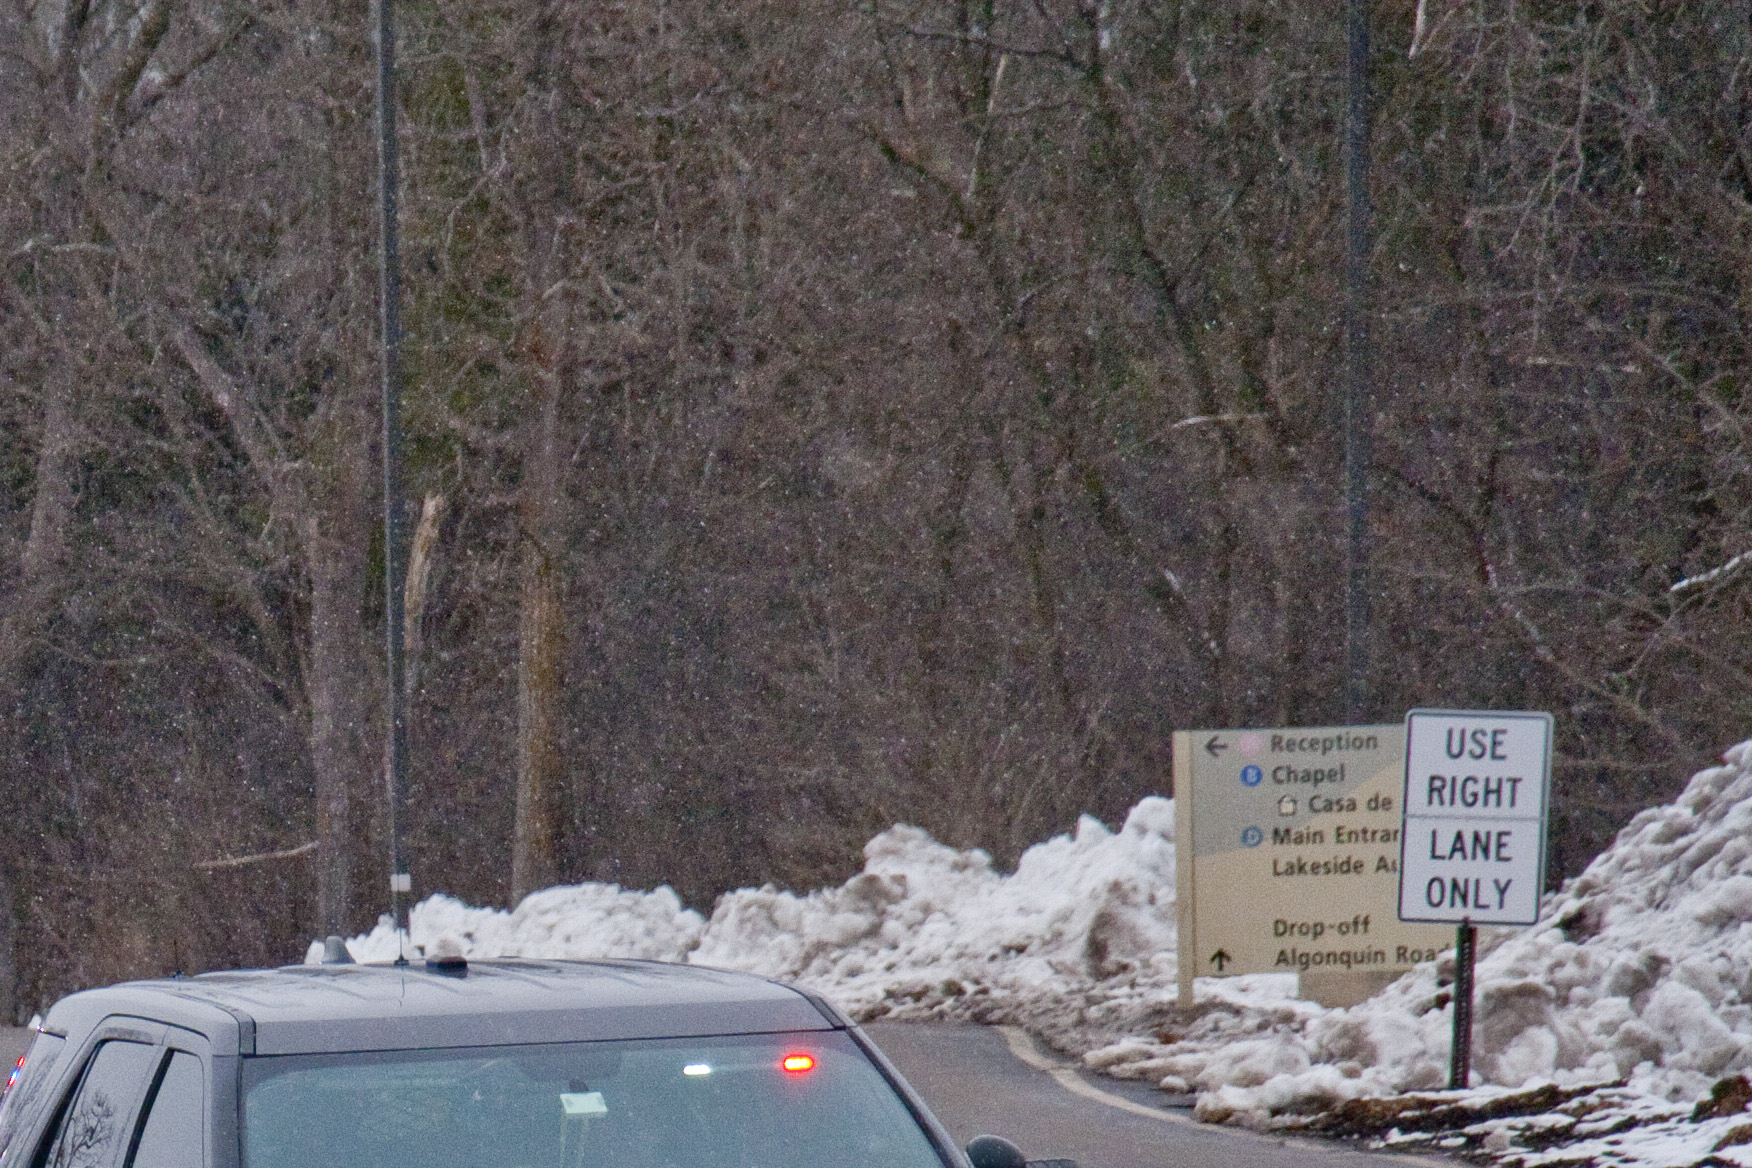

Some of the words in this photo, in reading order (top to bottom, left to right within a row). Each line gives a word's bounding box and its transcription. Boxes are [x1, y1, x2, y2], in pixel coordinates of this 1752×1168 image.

[1270, 732, 1379, 755] Reception
[1447, 727, 1508, 760] USE
[1271, 763, 1346, 787] Chapel
[1308, 794, 1357, 813] Casa
[1366, 791, 1394, 811] de
[1427, 774, 1523, 808] RIGHT
[1272, 826, 1325, 845] Main
[1430, 828, 1513, 862] LANE
[1272, 855, 1365, 877] Lakeside
[1426, 876, 1513, 910] ONLY
[1273, 914, 1371, 940] Drop-off
[1274, 947, 1386, 970] Algonquin
[1395, 943, 1450, 964] Roa
